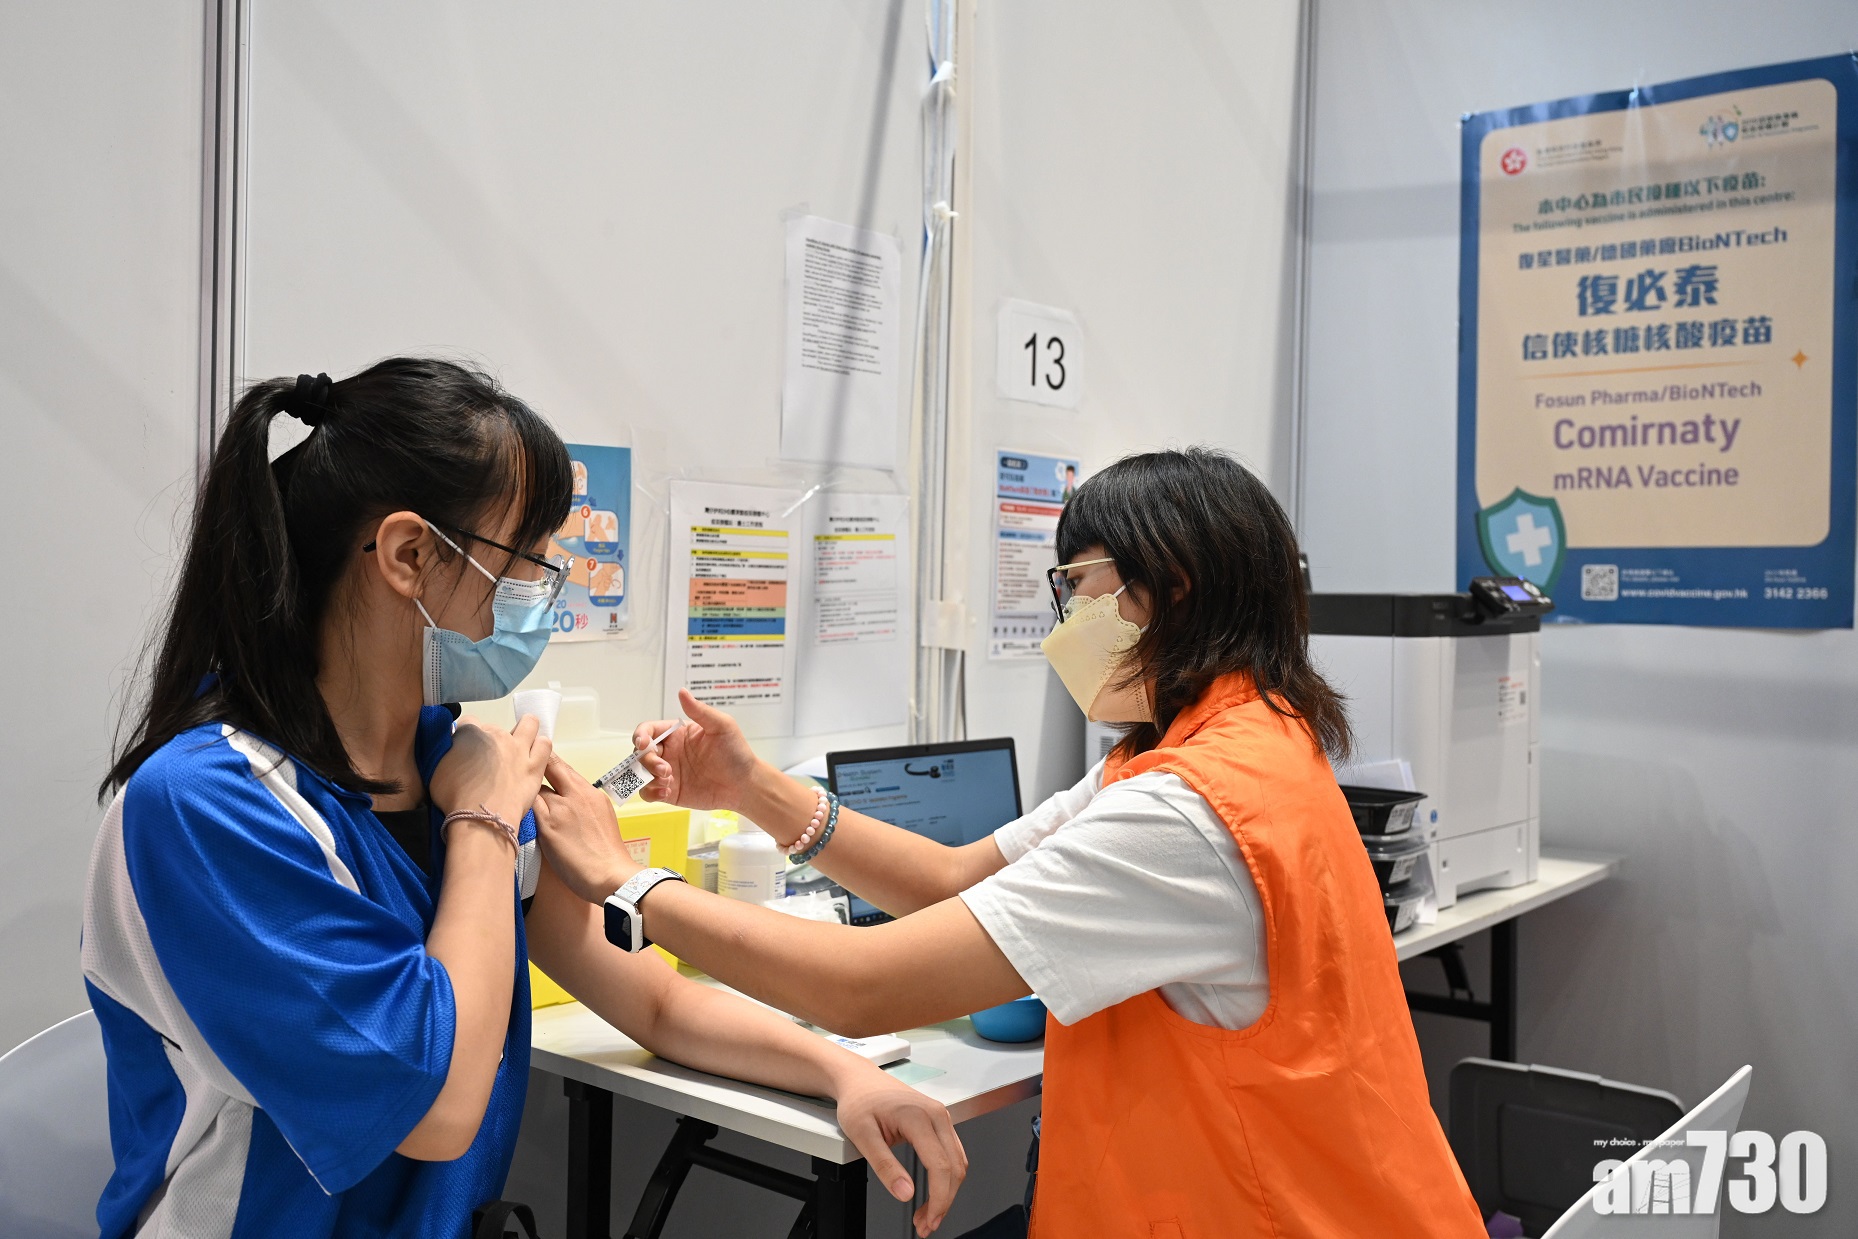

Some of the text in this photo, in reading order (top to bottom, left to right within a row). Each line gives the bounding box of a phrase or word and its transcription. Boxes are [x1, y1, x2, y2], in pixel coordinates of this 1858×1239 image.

[1513, 223, 1530, 233] The
[1533, 216, 1583, 231] following
[1586, 212, 1625, 224] vaccine
[1628, 210, 1636, 219] is
[1639, 203, 1714, 217] administered
[1717, 200, 1726, 208] in
[1729, 195, 1751, 207] this
[1577, 264, 1720, 317] 復必泰
[1522, 316, 1773, 361] 信使核糖核酸疫苗
[1024, 333, 1066, 390] 13
[1535, 381, 1762, 409] Fosun Pharma/BioNTech
[1554, 413, 1741, 451] Comirnaty
[1554, 463, 1739, 490] mRNA Vaccine
[556, 600, 567, 609] 20
[1621, 588, 1748, 600] www.covidvaccine.gov.hk
[1764, 587, 1793, 599] 3142
